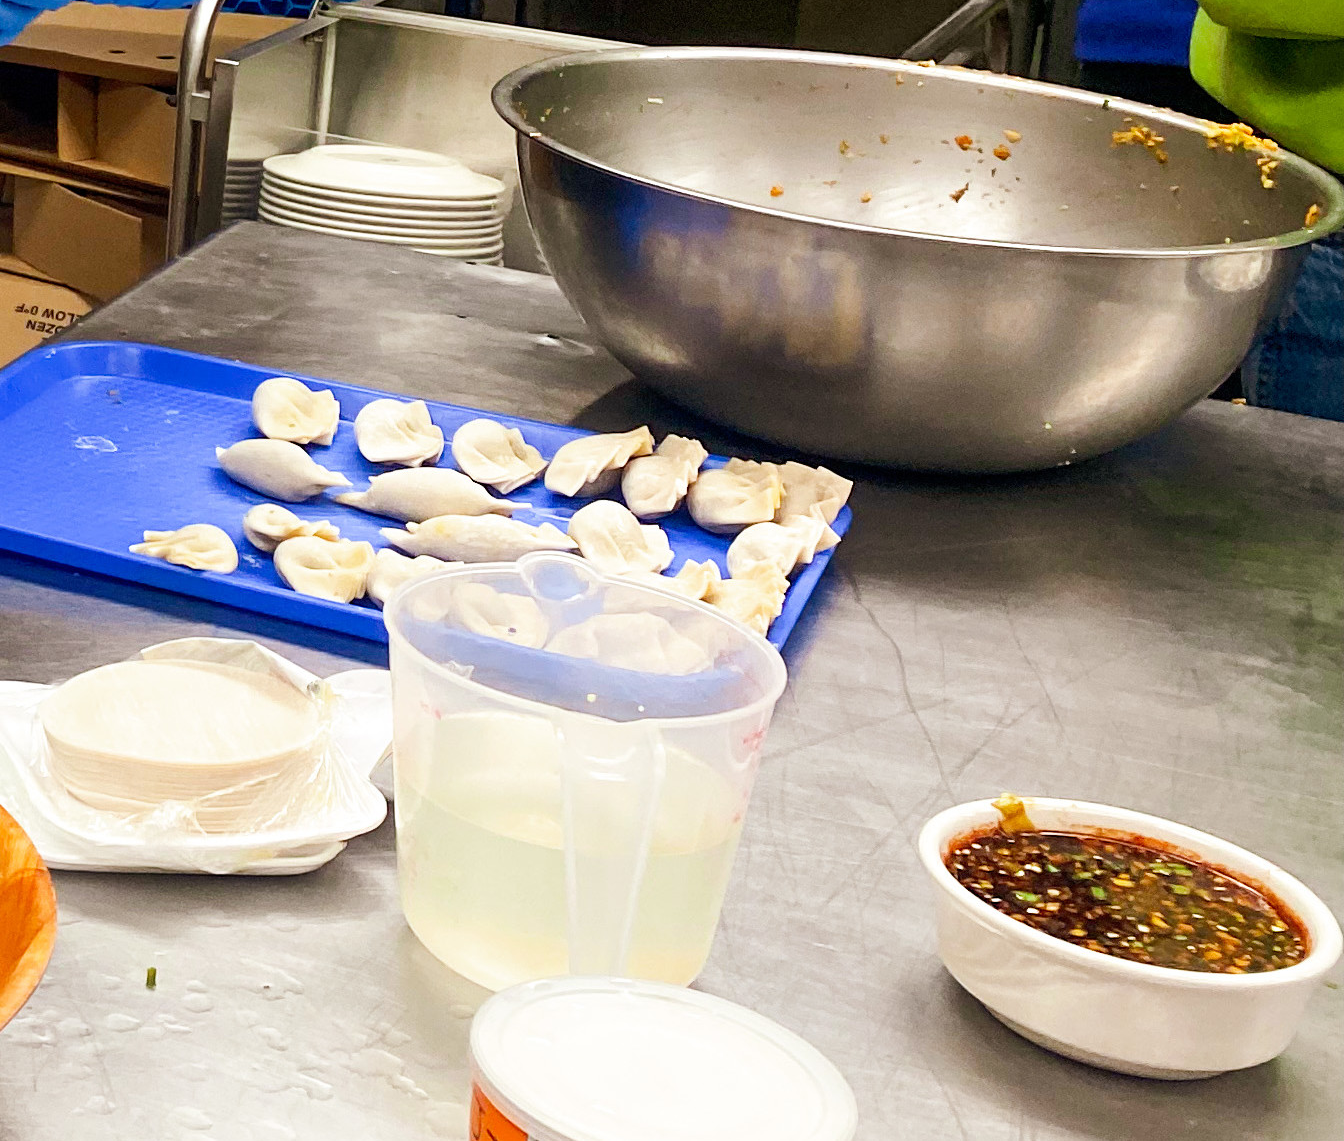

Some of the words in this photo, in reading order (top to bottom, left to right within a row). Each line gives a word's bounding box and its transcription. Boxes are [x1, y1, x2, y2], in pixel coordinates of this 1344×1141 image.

[14, 303, 39, 316] 0°F
[41, 308, 82, 324] LOW
[25, 319, 65, 334] OZEN
